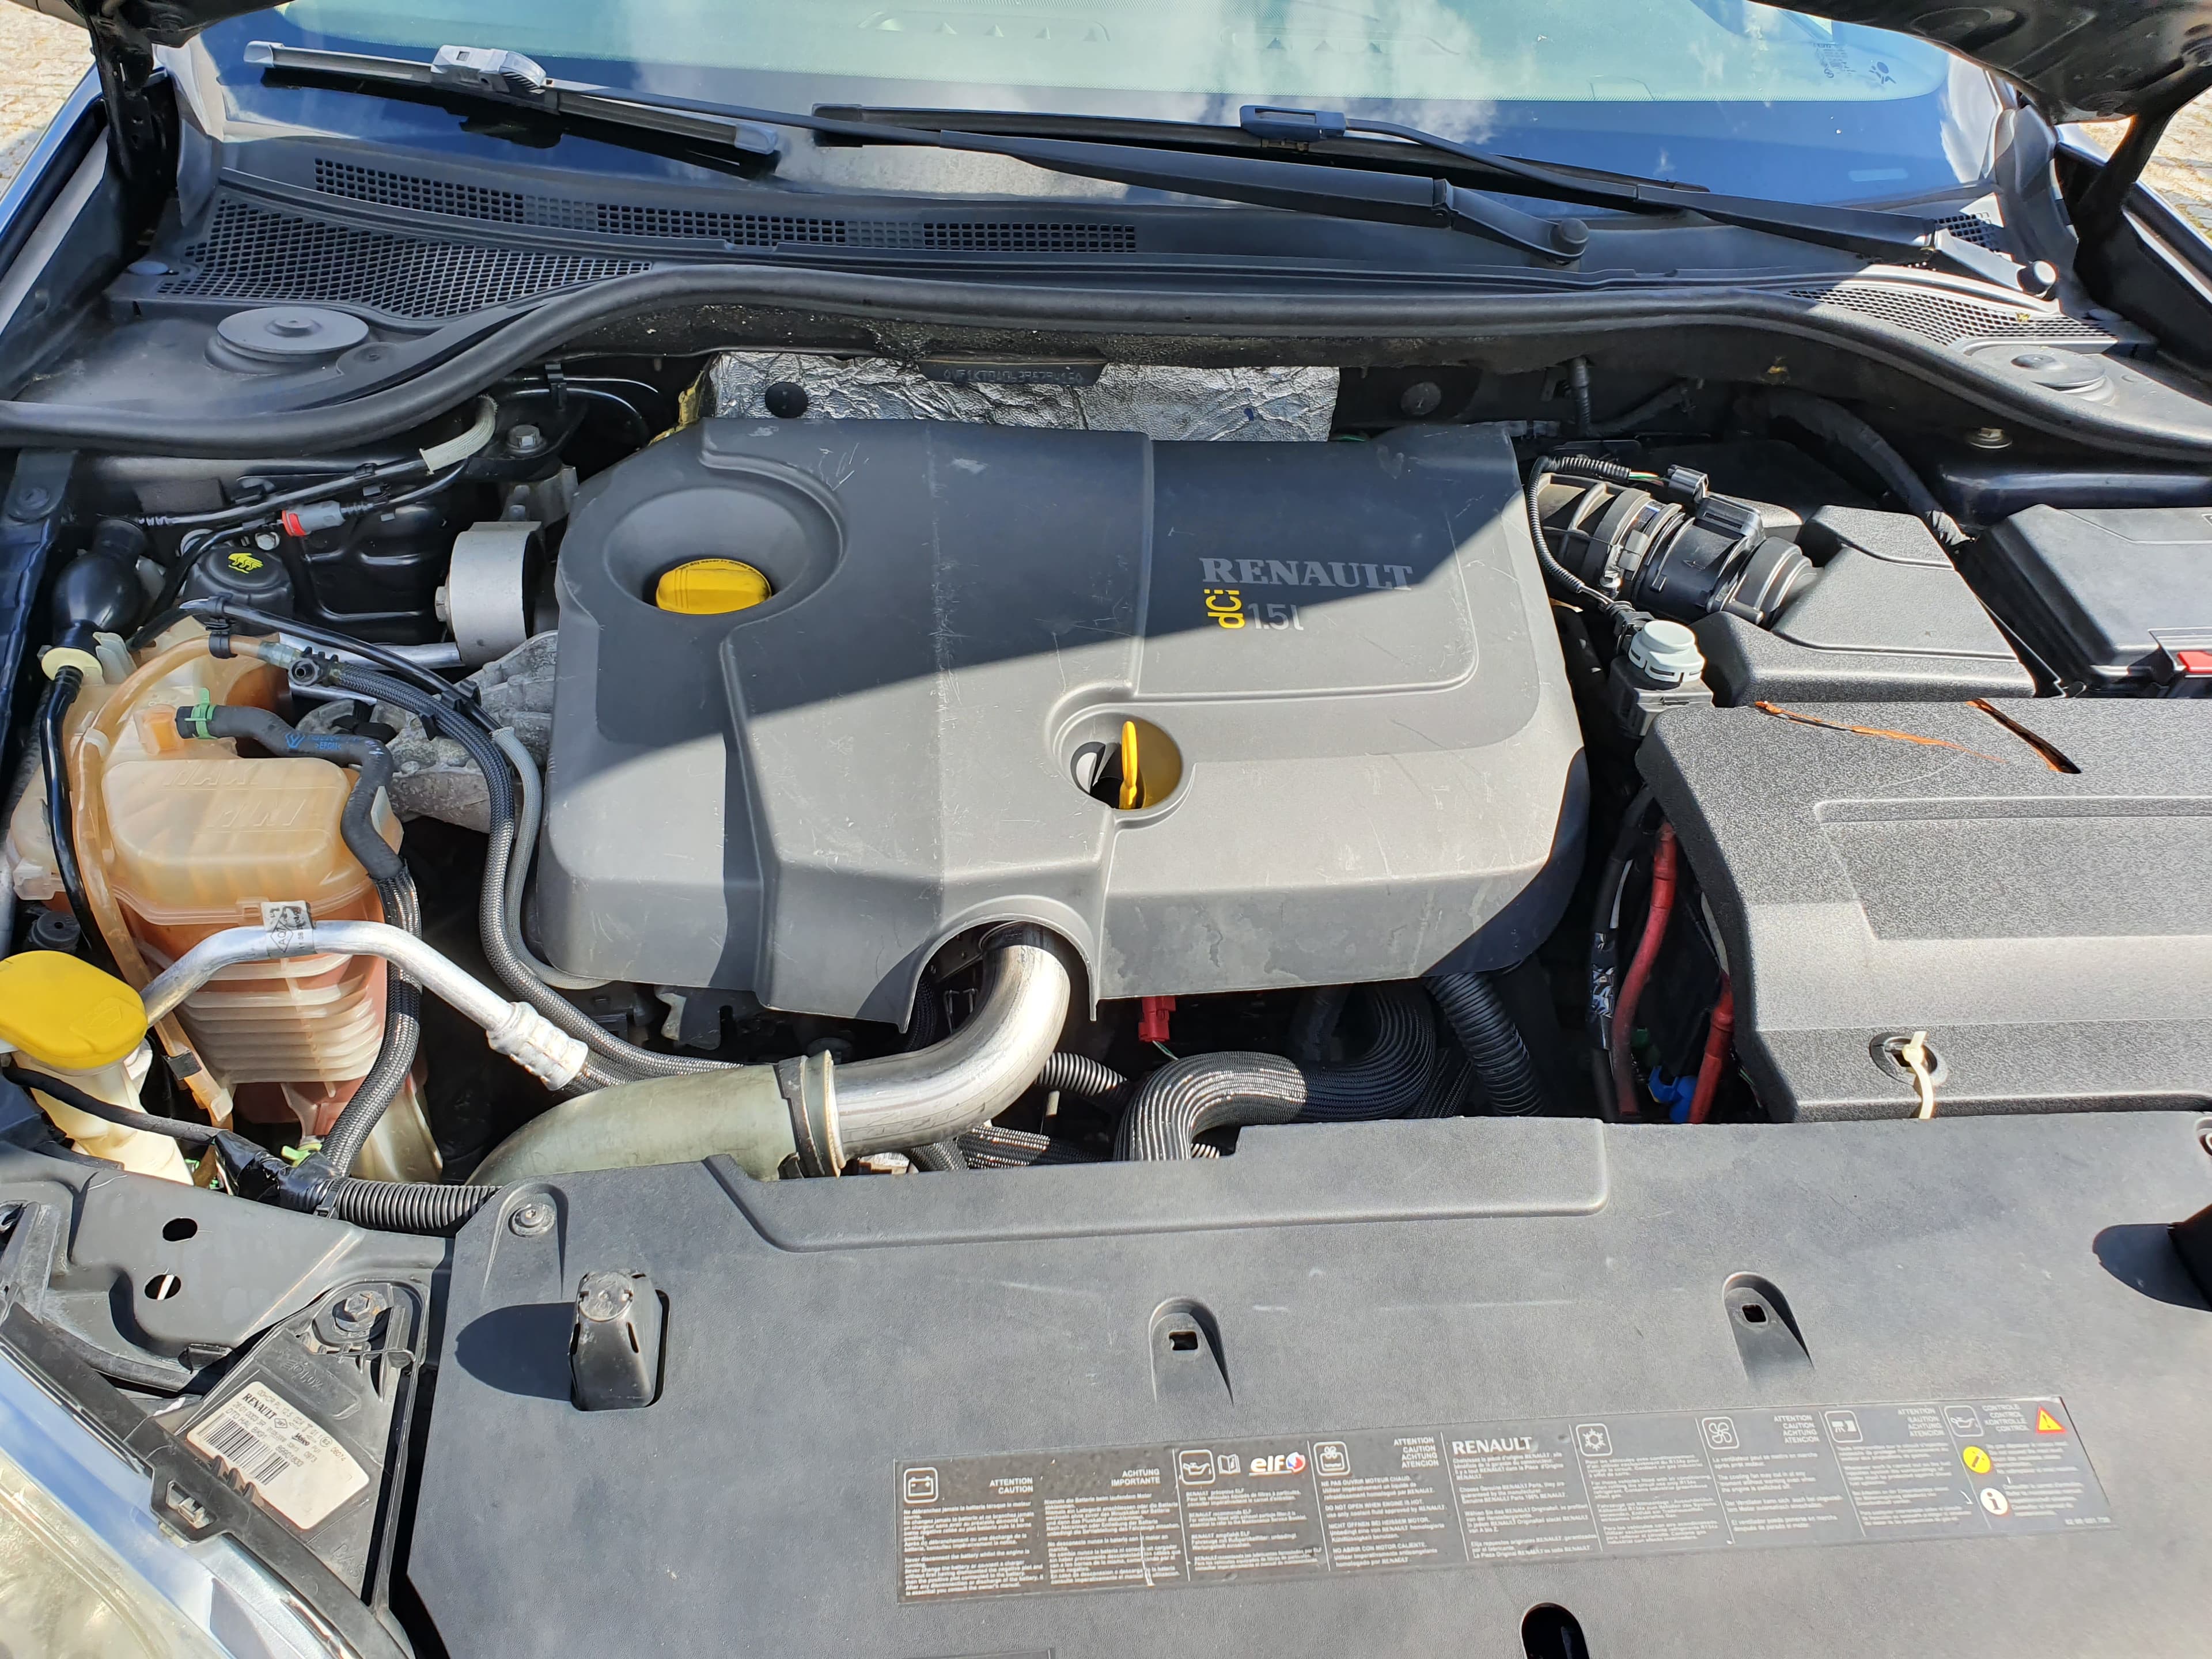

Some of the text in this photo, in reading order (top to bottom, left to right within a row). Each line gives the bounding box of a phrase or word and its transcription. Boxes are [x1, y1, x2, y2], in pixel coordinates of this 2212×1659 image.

[1199, 557, 1413, 590] RENAULT
[1204, 589, 1245, 628] dCi
[241, 1391, 277, 1422] RENAULT
[1393, 1437, 1434, 1446] ATTENTION
[1452, 1437, 1532, 1455] RENAULT
[1402, 1452, 1437, 1460] ACHTUNG
[1250, 1455, 1285, 1472] elf
[1402, 1460, 1439, 1468] ATENCION
[1122, 1468, 1160, 1478] ACHTUNG
[989, 1477, 1033, 1487] ATTENTION
[1111, 1476, 1160, 1487] IMPORTANTE
[998, 1486, 1033, 1494] CAUTION
